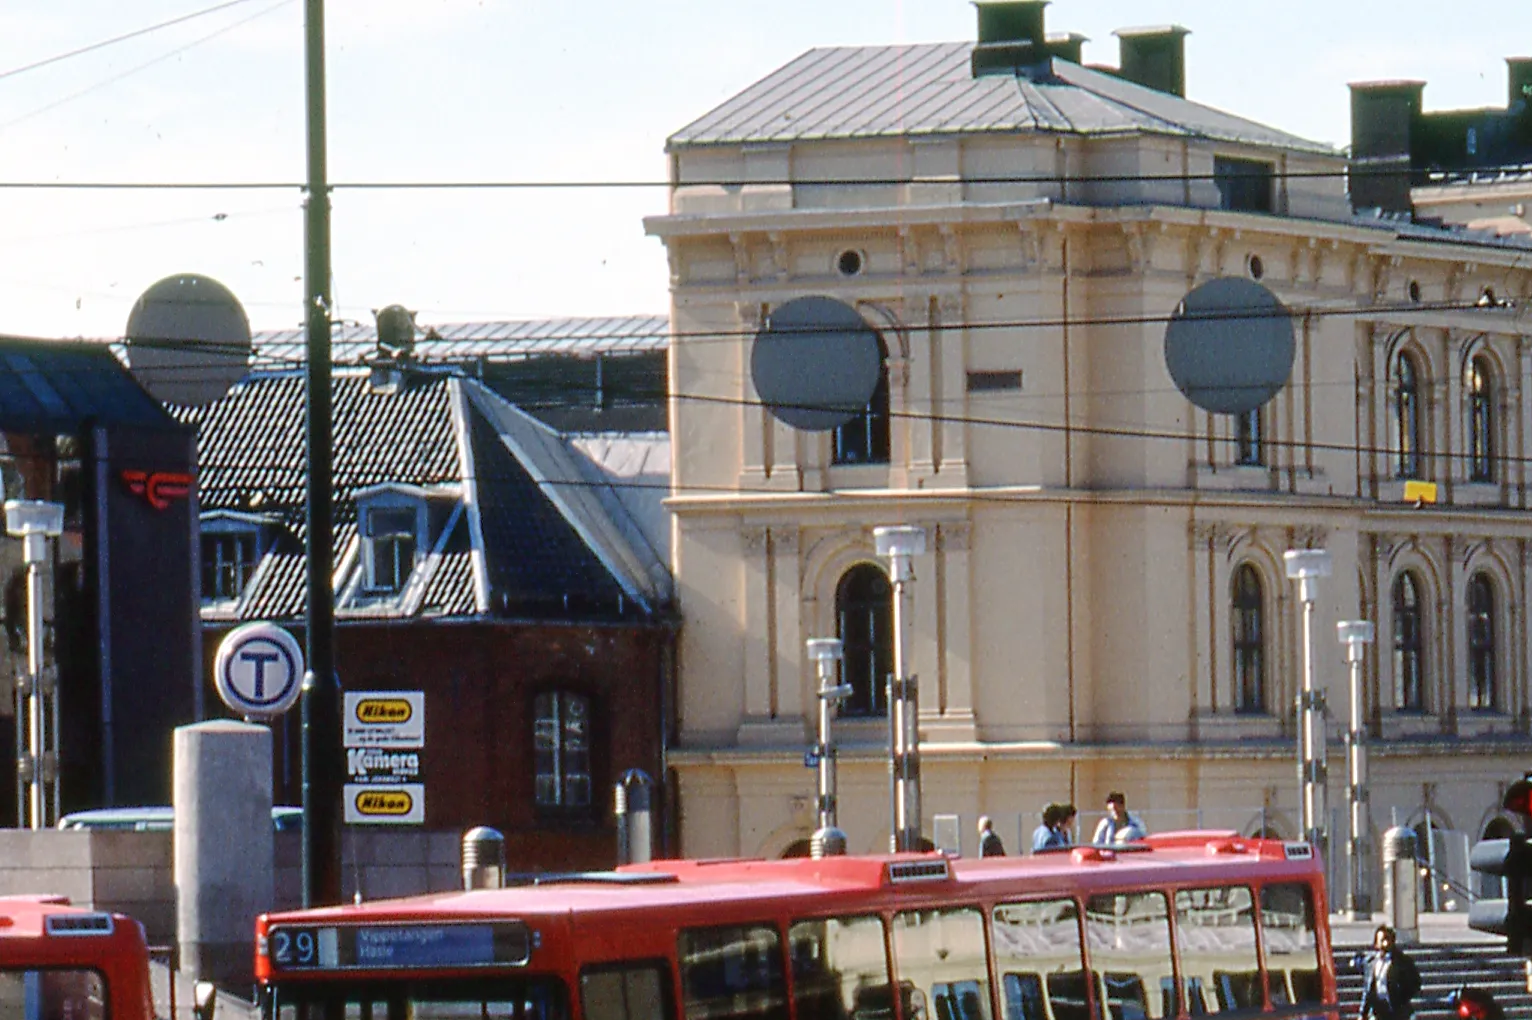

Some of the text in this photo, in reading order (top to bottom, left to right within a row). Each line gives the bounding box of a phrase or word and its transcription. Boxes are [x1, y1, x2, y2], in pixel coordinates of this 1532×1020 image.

[241, 652, 278, 697] T
[363, 705, 405, 717] Nikon
[347, 748, 418, 774] Kamera
[362, 797, 405, 809] Nikon
[275, 932, 313, 962] 29
